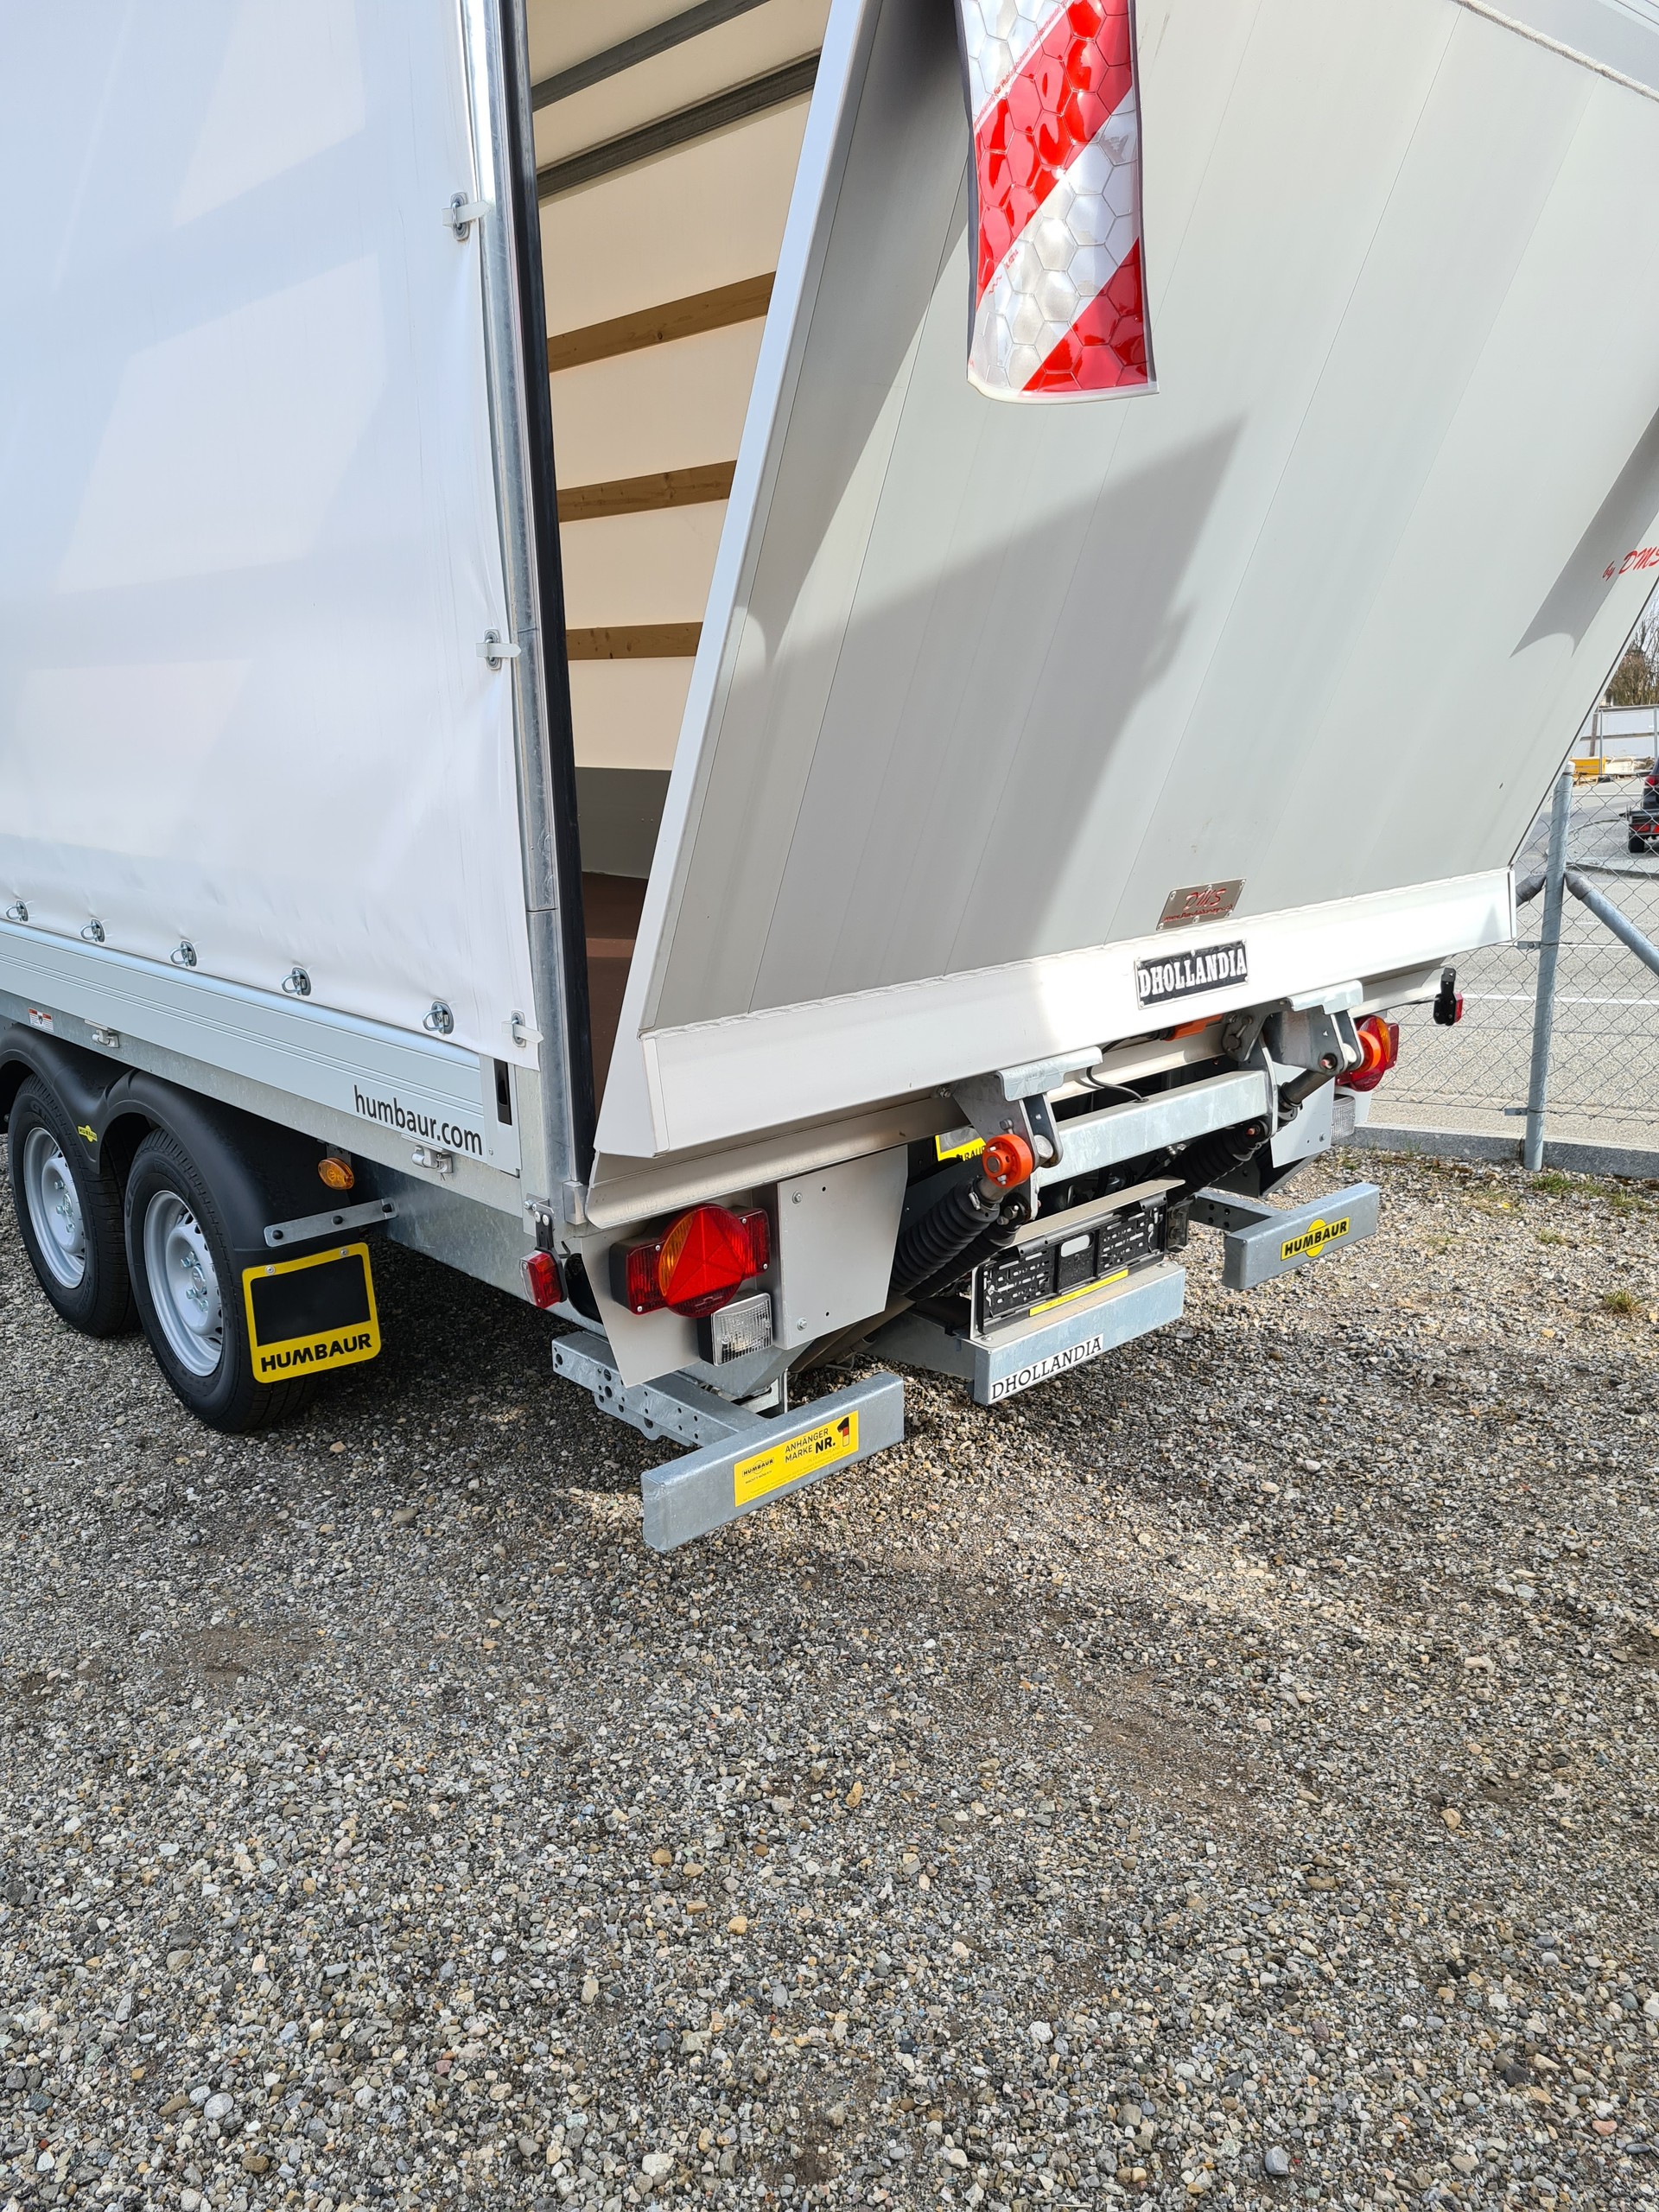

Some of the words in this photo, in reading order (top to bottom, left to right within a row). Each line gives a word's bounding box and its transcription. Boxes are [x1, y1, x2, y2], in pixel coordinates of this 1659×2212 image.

[1183, 888, 1227, 910] DMS
[1137, 948, 1247, 998] DHOLLANDIA
[353, 1084, 483, 1155] humbaur.com
[1284, 1221, 1347, 1256] HUMBAUR
[261, 1333, 372, 1372] HUMBAUR
[991, 1337, 1103, 1400] DHOLLANDIA
[785, 1427, 829, 1453] ANHÄNGER
[785, 1446, 813, 1463] MARKE
[815, 1436, 836, 1454] NR.
[743, 1459, 773, 1476] HUMBAUR
